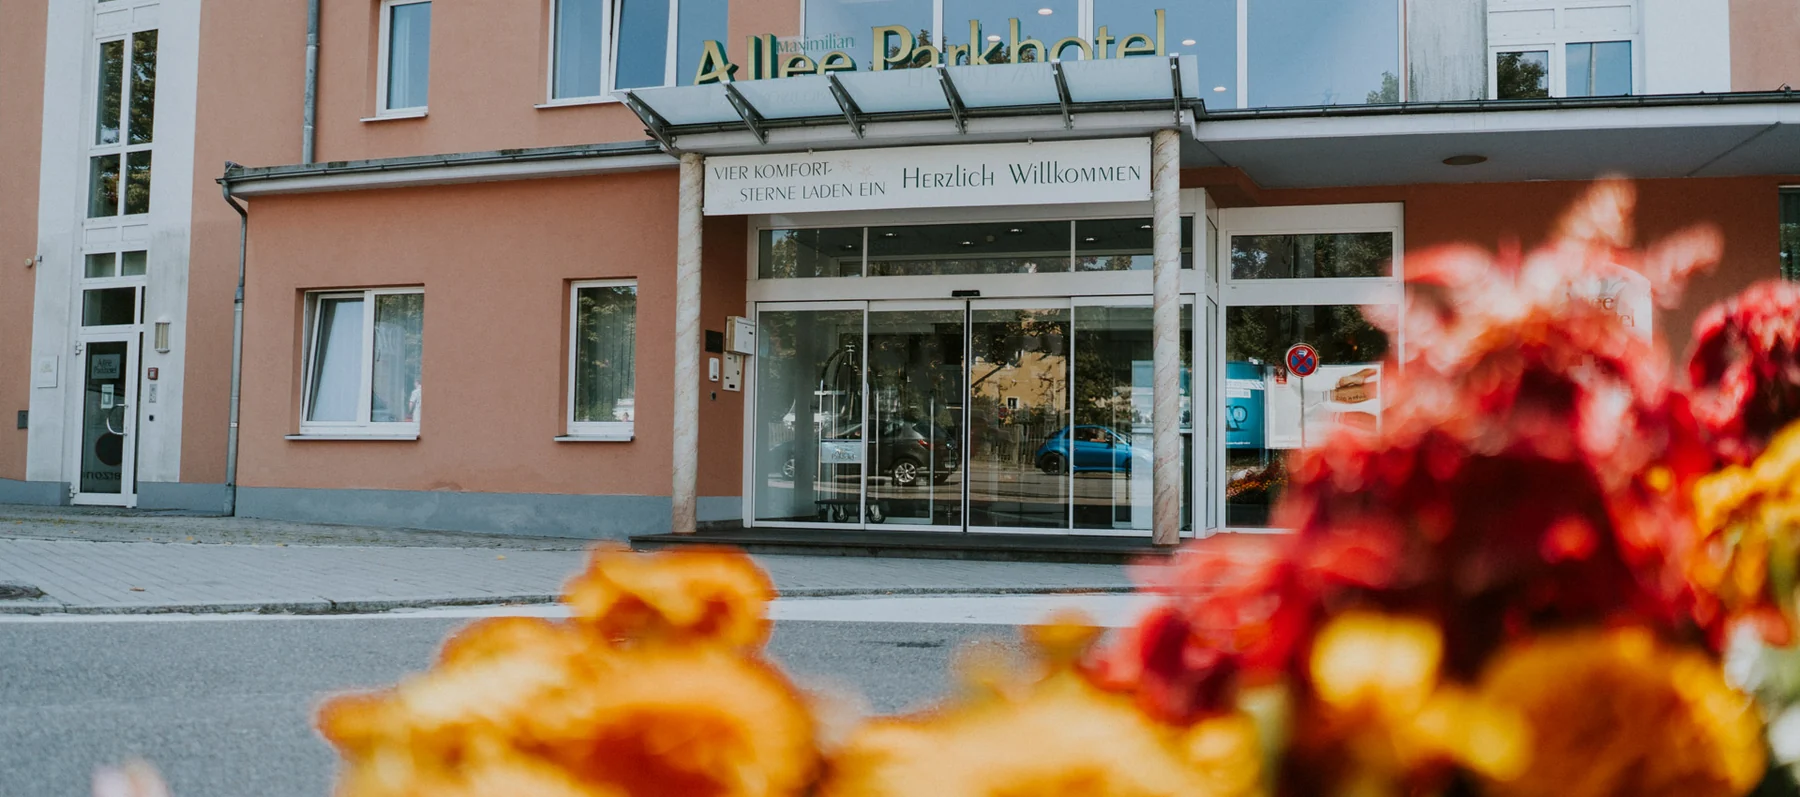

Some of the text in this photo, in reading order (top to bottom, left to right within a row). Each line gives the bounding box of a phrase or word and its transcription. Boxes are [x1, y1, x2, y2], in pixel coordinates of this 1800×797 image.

[694, 9, 1166, 86] Allee Parkhotel
[777, 33, 856, 53] Maximilian
[714, 161, 833, 180] VIER KOMFORT-
[740, 181, 886, 202] STERNE LADEN EIN
